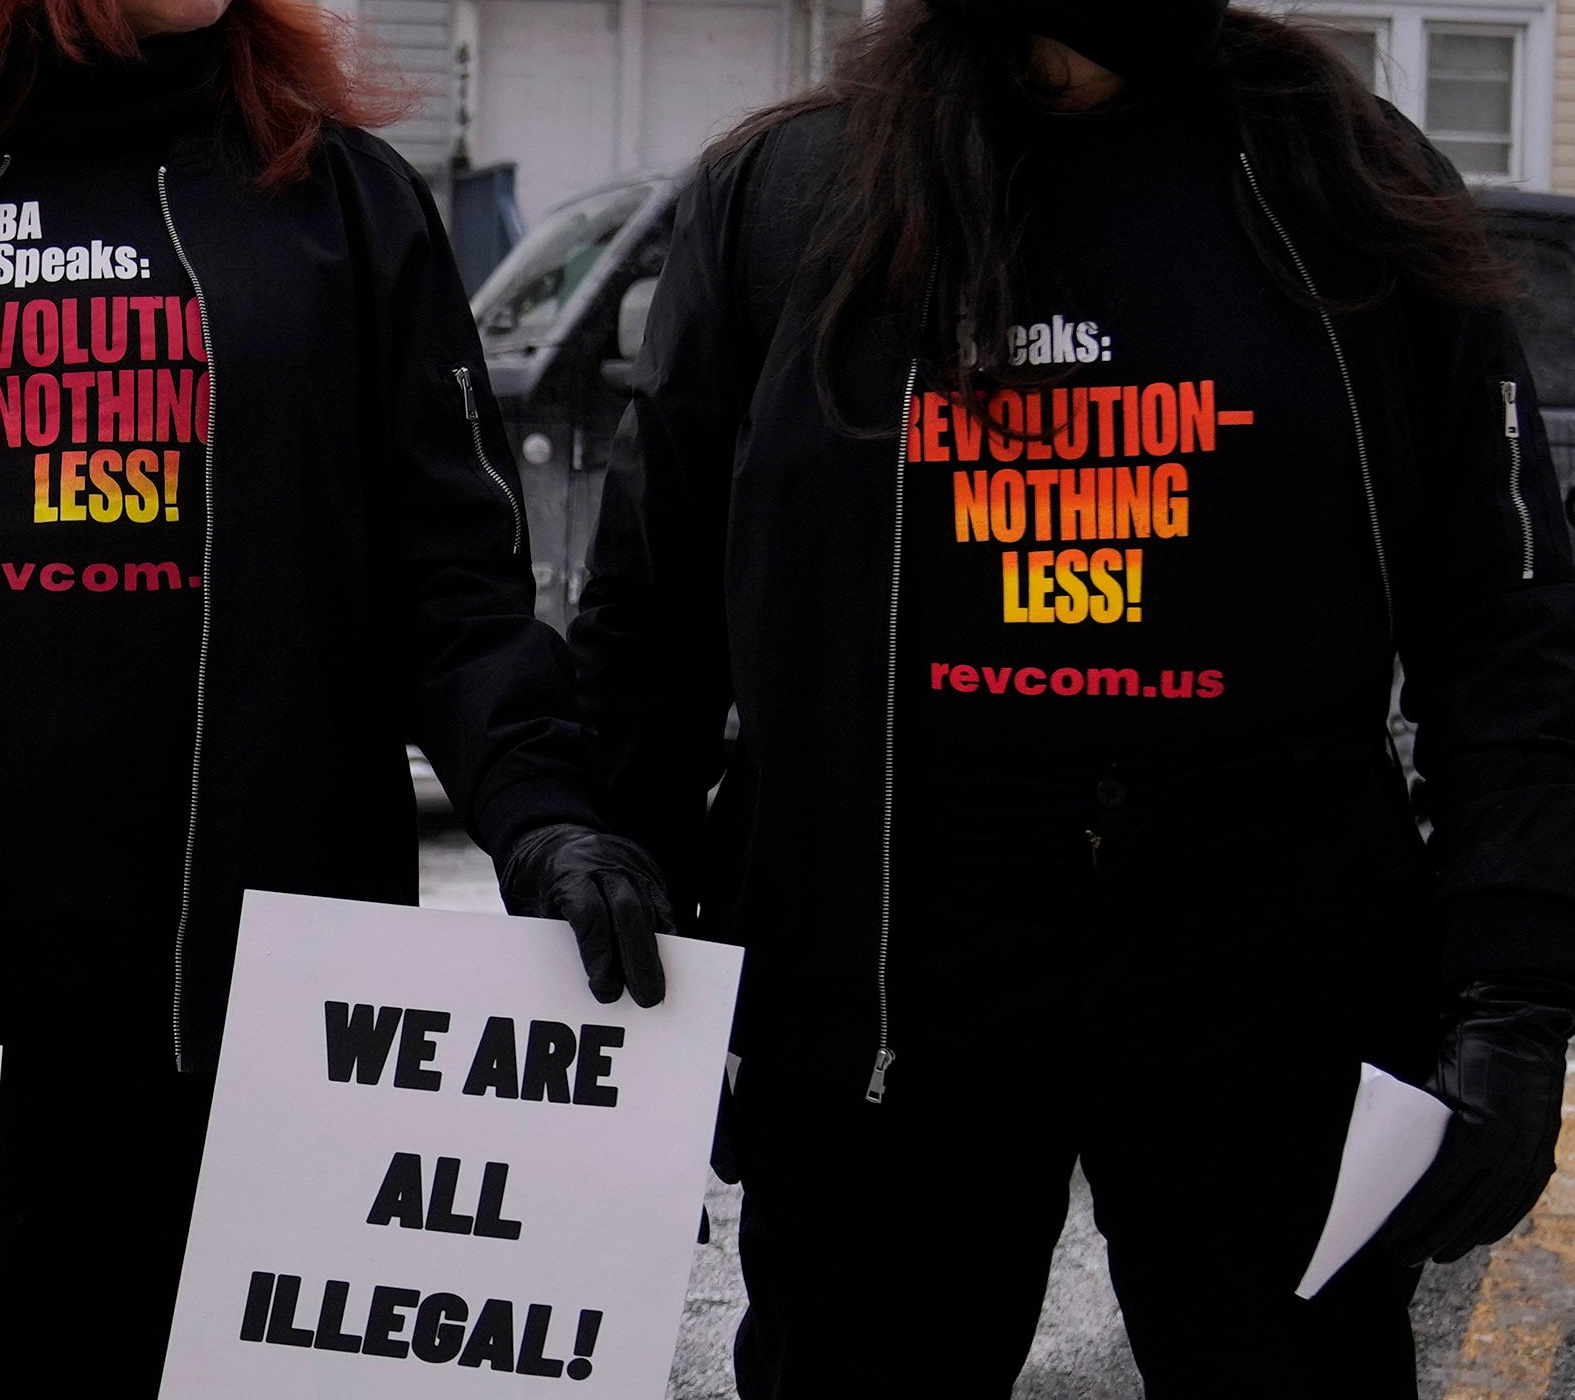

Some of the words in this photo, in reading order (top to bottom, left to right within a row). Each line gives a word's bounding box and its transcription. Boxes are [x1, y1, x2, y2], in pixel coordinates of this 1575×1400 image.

[34, 449, 180, 523] LESS!
[954, 463, 1189, 542] NOTHING
[1002, 548, 1143, 624] LESS!
[931, 663, 1224, 698] revcom.us
[325, 1001, 451, 1092] WE
[462, 1016, 625, 1107] ARE
[366, 1152, 522, 1240] ALL
[240, 1271, 603, 1380] ILLEGAL!
